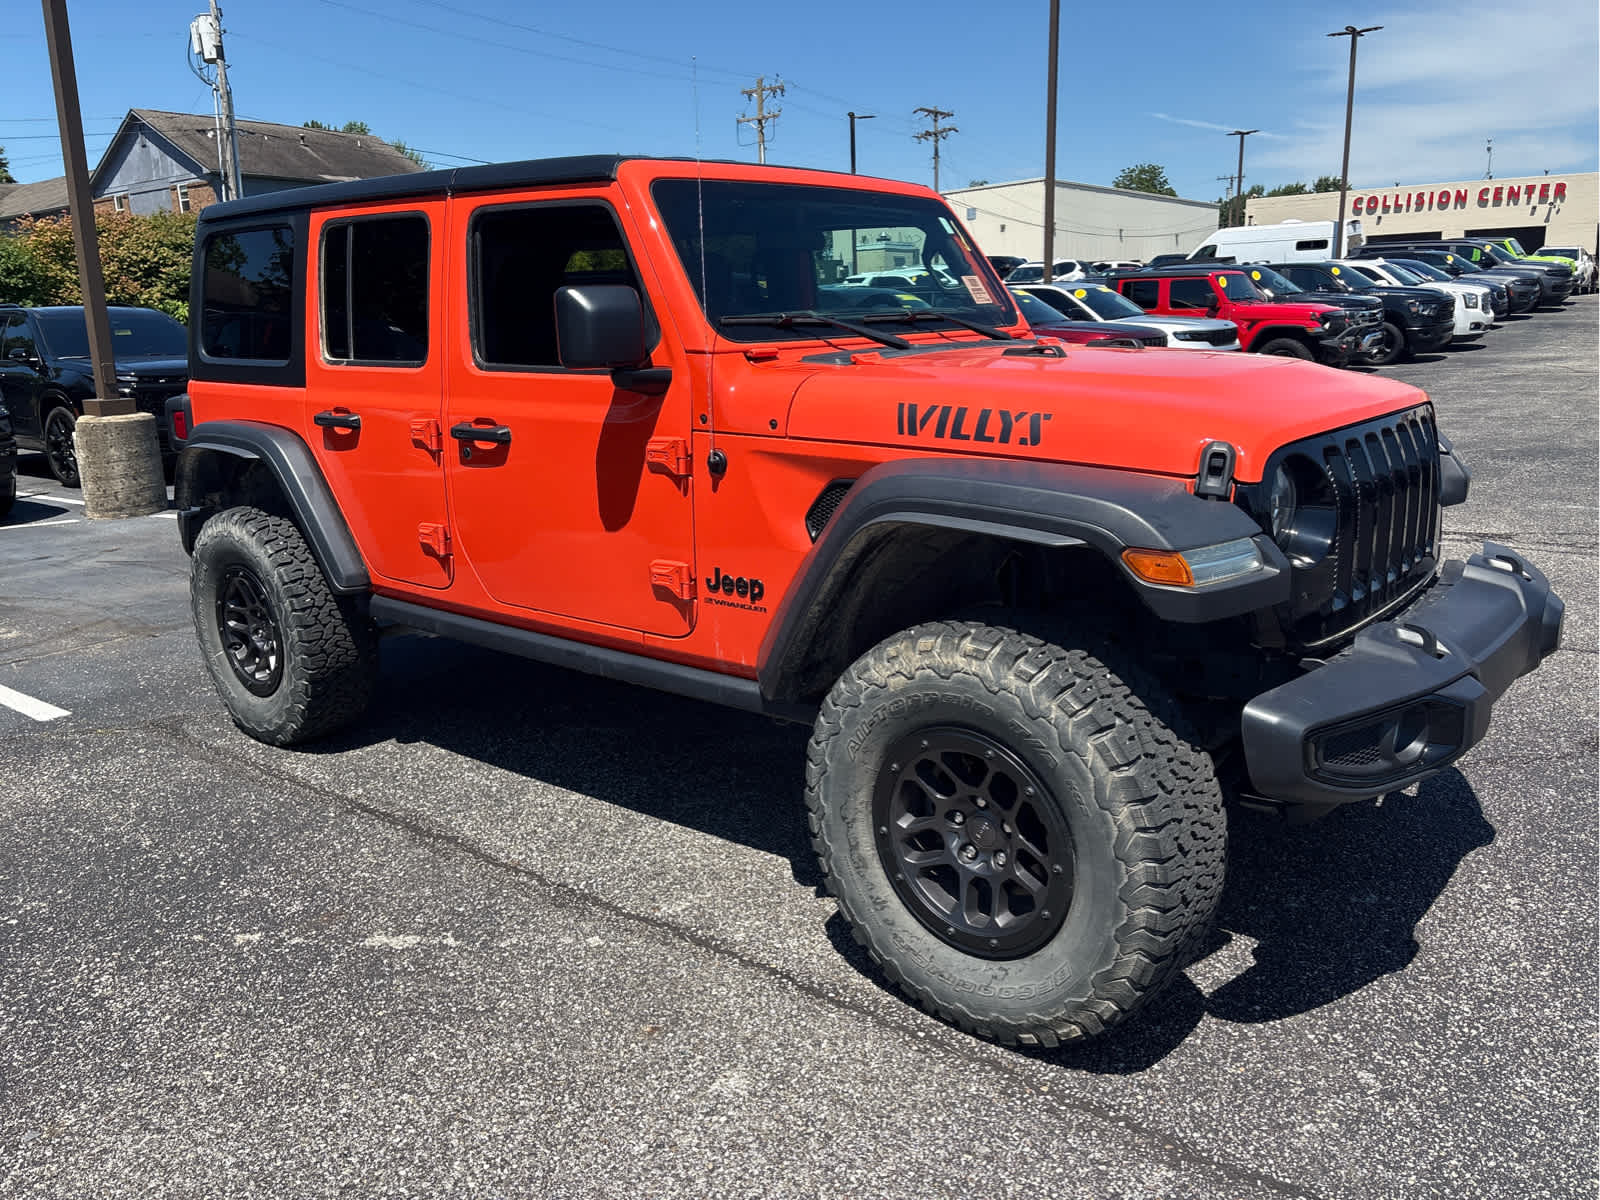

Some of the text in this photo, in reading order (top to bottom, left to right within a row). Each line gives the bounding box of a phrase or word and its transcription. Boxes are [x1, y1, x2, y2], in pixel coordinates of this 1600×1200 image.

[1352, 182, 1567, 213] COLLISION CENTER
[897, 402, 1053, 447] WILLYS
[705, 567, 765, 604] Jeep
[713, 599, 767, 613] WRANGLER
[847, 690, 995, 761] All-Terrain
